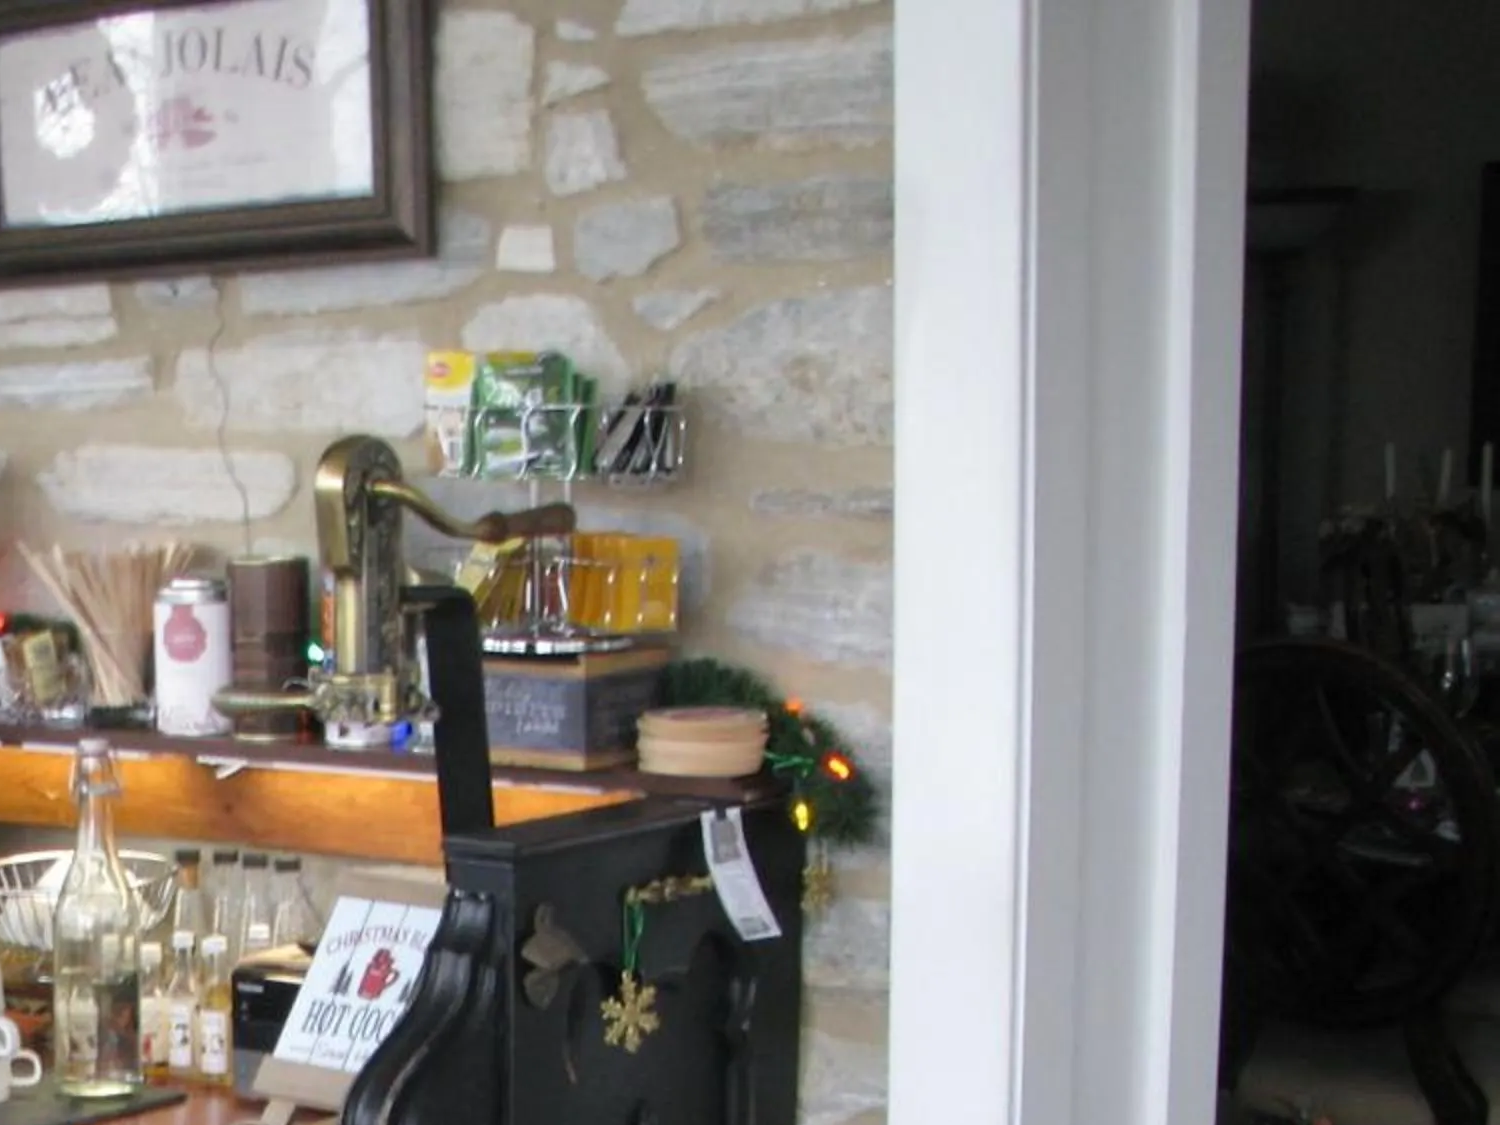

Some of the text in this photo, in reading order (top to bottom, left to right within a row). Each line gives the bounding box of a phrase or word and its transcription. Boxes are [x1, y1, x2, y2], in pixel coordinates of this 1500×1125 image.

[326, 926, 408, 955] CHRISTMAS
[302, 999, 395, 1042] HOT COC
